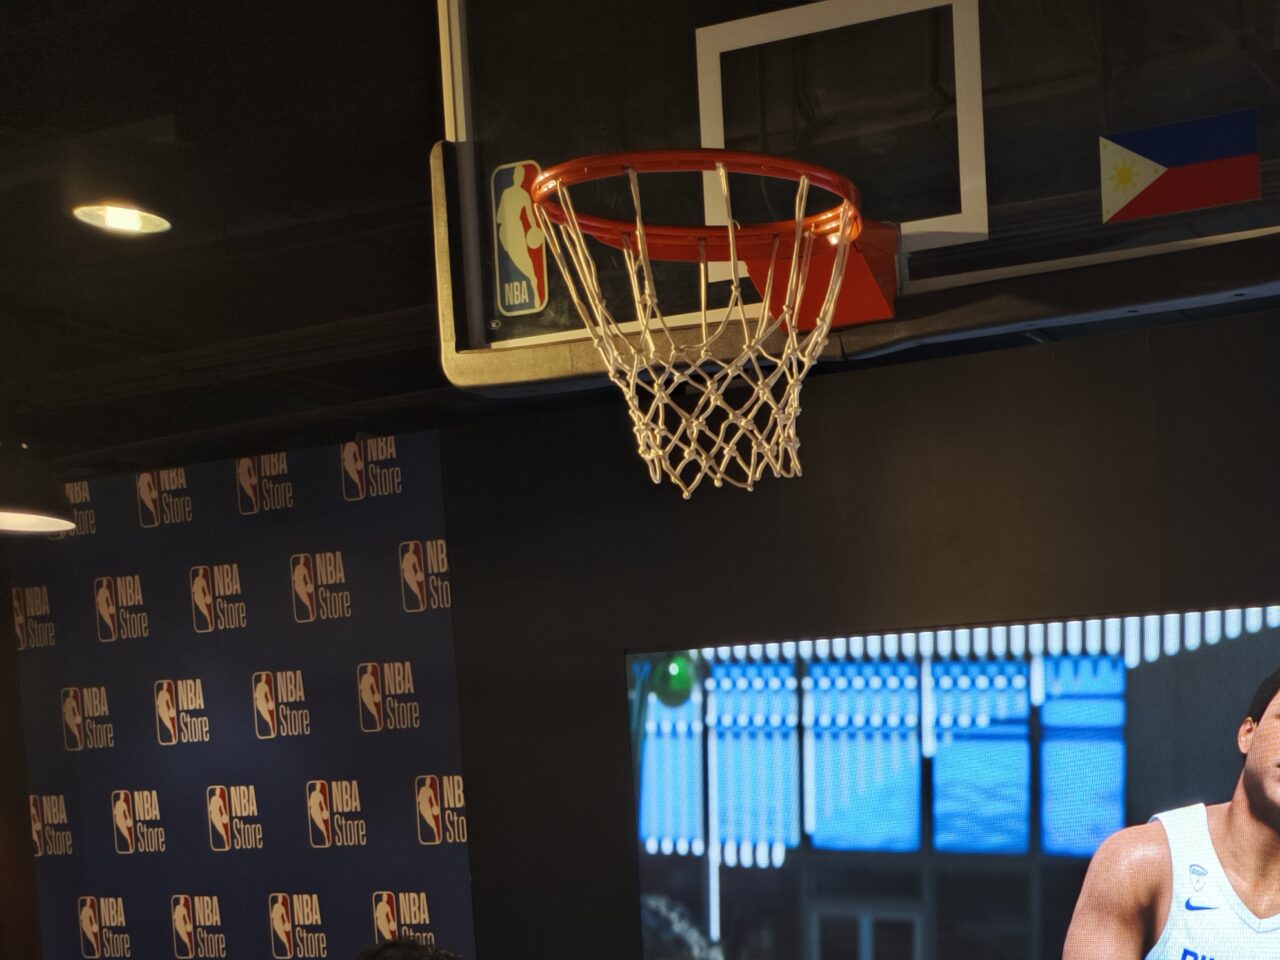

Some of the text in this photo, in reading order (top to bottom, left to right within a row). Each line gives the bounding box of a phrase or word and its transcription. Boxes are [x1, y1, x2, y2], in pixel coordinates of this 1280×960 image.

[504, 280, 529, 306] NBA
[260, 451, 288, 477] NBA
[367, 435, 397, 462] NBA
[159, 467, 187, 492] NBA
[261, 478, 294, 511] Store
[368, 463, 402, 497] Store
[162, 493, 193, 525] Store
[213, 563, 241, 597] NBA
[315, 551, 346, 585] NBA
[25, 585, 50, 617] NBA
[116, 574, 143, 607] NBA
[318, 587, 351, 620] Store
[119, 608, 149, 639] Store
[216, 598, 247, 630] Store
[276, 670, 305, 703] NBA
[383, 661, 415, 695] NBA
[82, 686, 109, 717] NBA
[177, 678, 205, 711] NBA
[179, 711, 210, 743] Store
[278, 704, 311, 737] Store
[385, 696, 420, 730] Store
[85, 719, 115, 749] Store
[42, 794, 68, 825] NBA
[133, 789, 161, 821] NBA
[230, 784, 258, 817] NBA
[331, 779, 362, 813] NBA
[44, 826, 73, 856] Store
[136, 822, 166, 853] Store
[232, 818, 264, 850] Store
[333, 814, 367, 847] Store
[100, 896, 126, 927] NBA
[194, 895, 222, 927] NBA
[292, 893, 322, 926] NBA
[398, 892, 430, 925] NBA
[101, 927, 132, 958] Store
[196, 928, 226, 958] Store
[295, 926, 328, 959] Store
